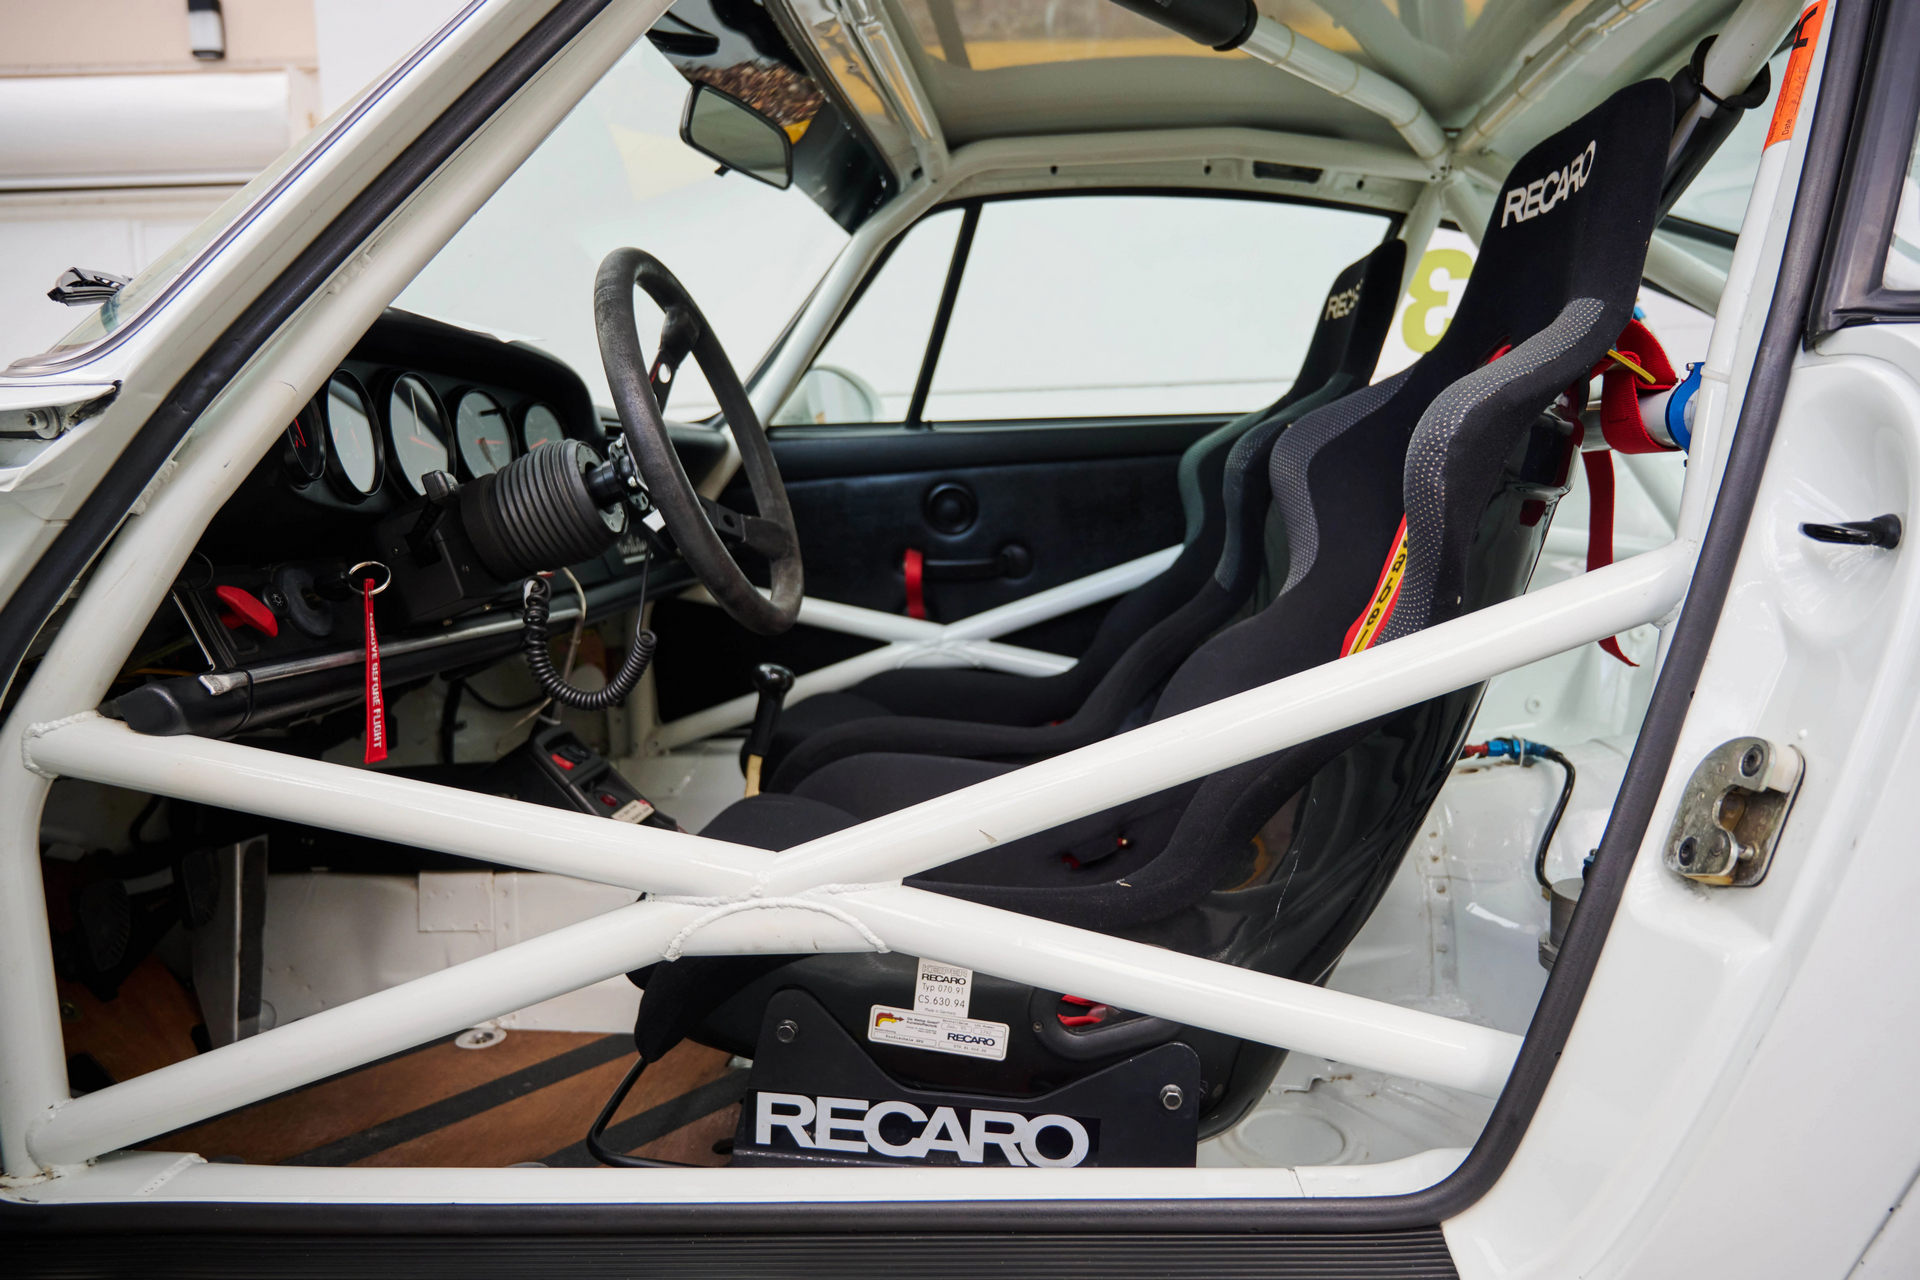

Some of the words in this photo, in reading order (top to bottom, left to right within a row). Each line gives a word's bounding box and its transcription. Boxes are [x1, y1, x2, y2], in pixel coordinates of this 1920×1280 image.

[1500, 139, 1597, 229] RECARO
[371, 662, 381, 707] BEFORE
[373, 708, 382, 748] FLIGHT
[921, 973, 967, 986] RECARO
[922, 982, 936, 993] Typ
[946, 1032, 997, 1047] RECARO
[755, 1091, 1090, 1169] RECARO
